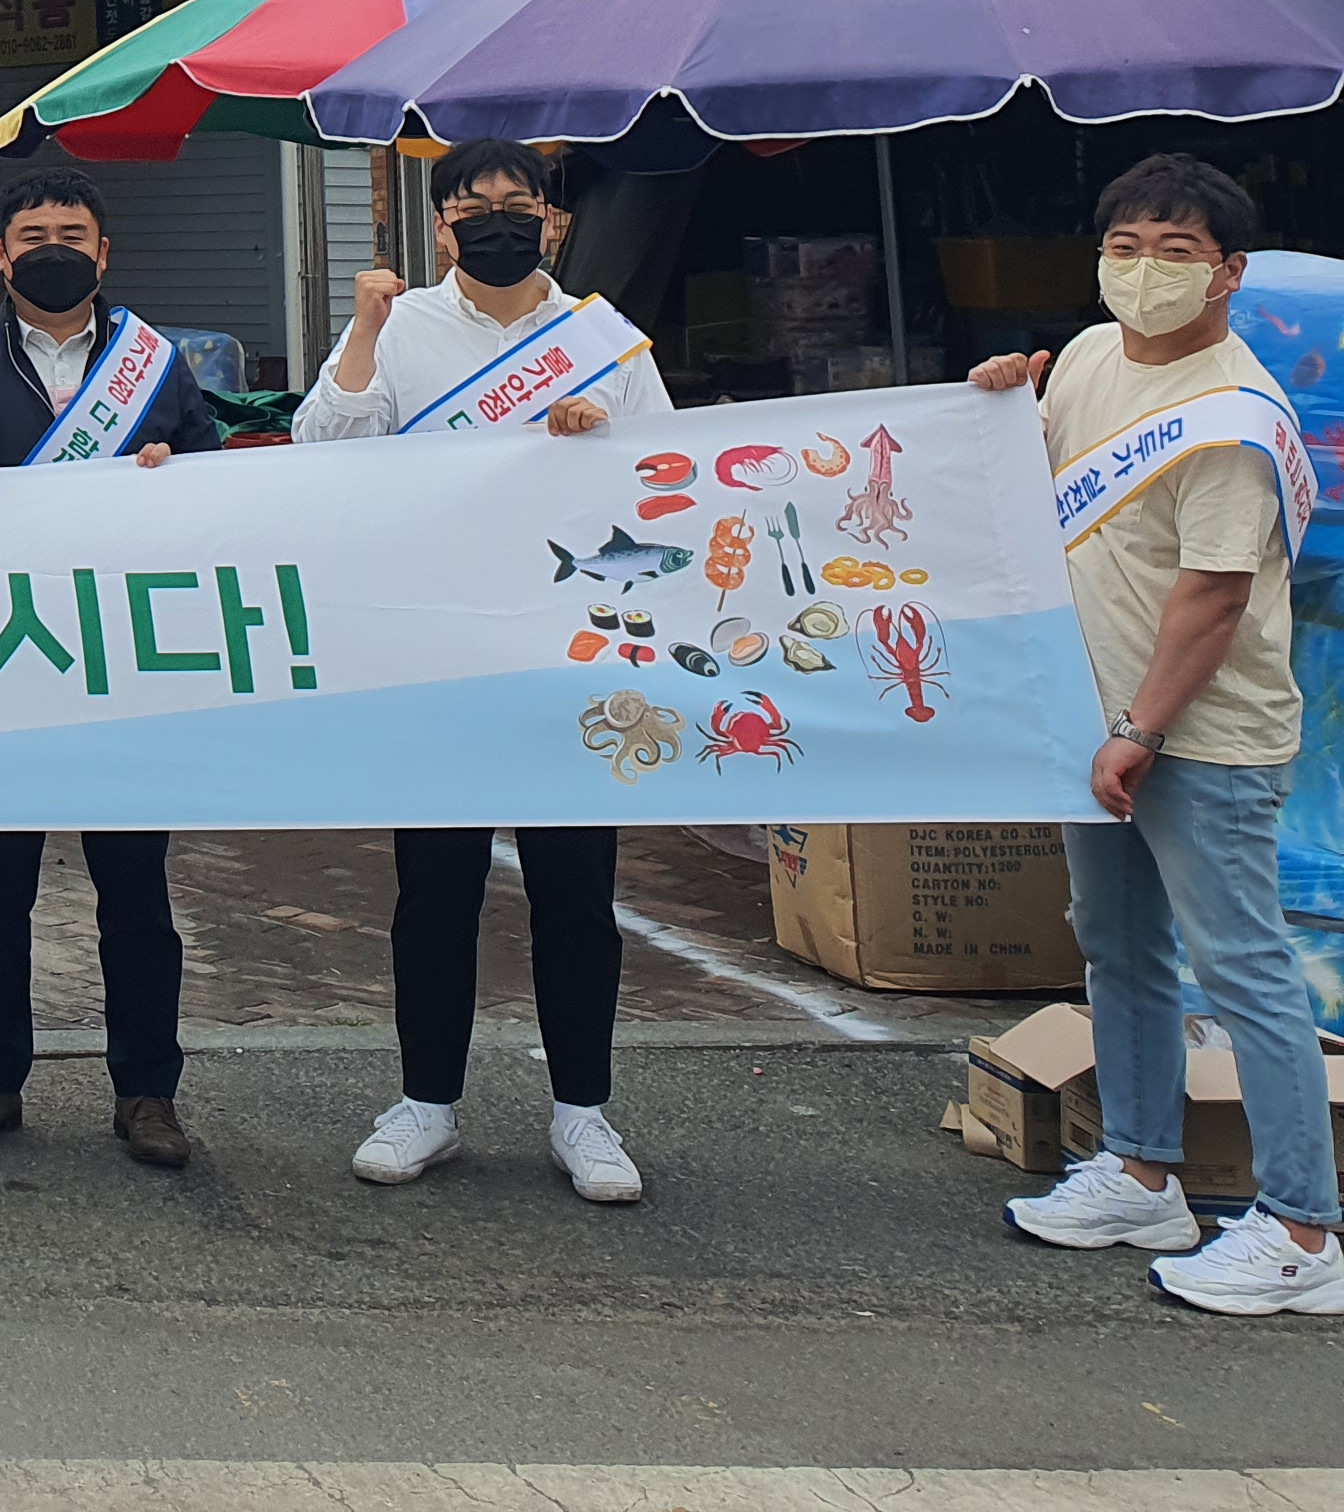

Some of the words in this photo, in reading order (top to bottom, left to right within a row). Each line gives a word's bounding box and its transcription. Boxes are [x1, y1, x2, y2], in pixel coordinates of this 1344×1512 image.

[107, 325, 161, 405] 물가안정
[478, 345, 575, 423] 물가안정
[89, 399, 119, 432] 다
[1112, 417, 1183, 479] 모두가
[910, 828, 938, 841] DJC
[946, 828, 993, 841] KOREA
[911, 877, 971, 891] CARTON
[978, 878, 1001, 890] NO:
[912, 894, 957, 907] STYLE
[966, 894, 990, 906] NO:
[914, 943, 954, 955] MADE
[964, 943, 979, 954] IN
[989, 943, 1032, 955] CHINA
